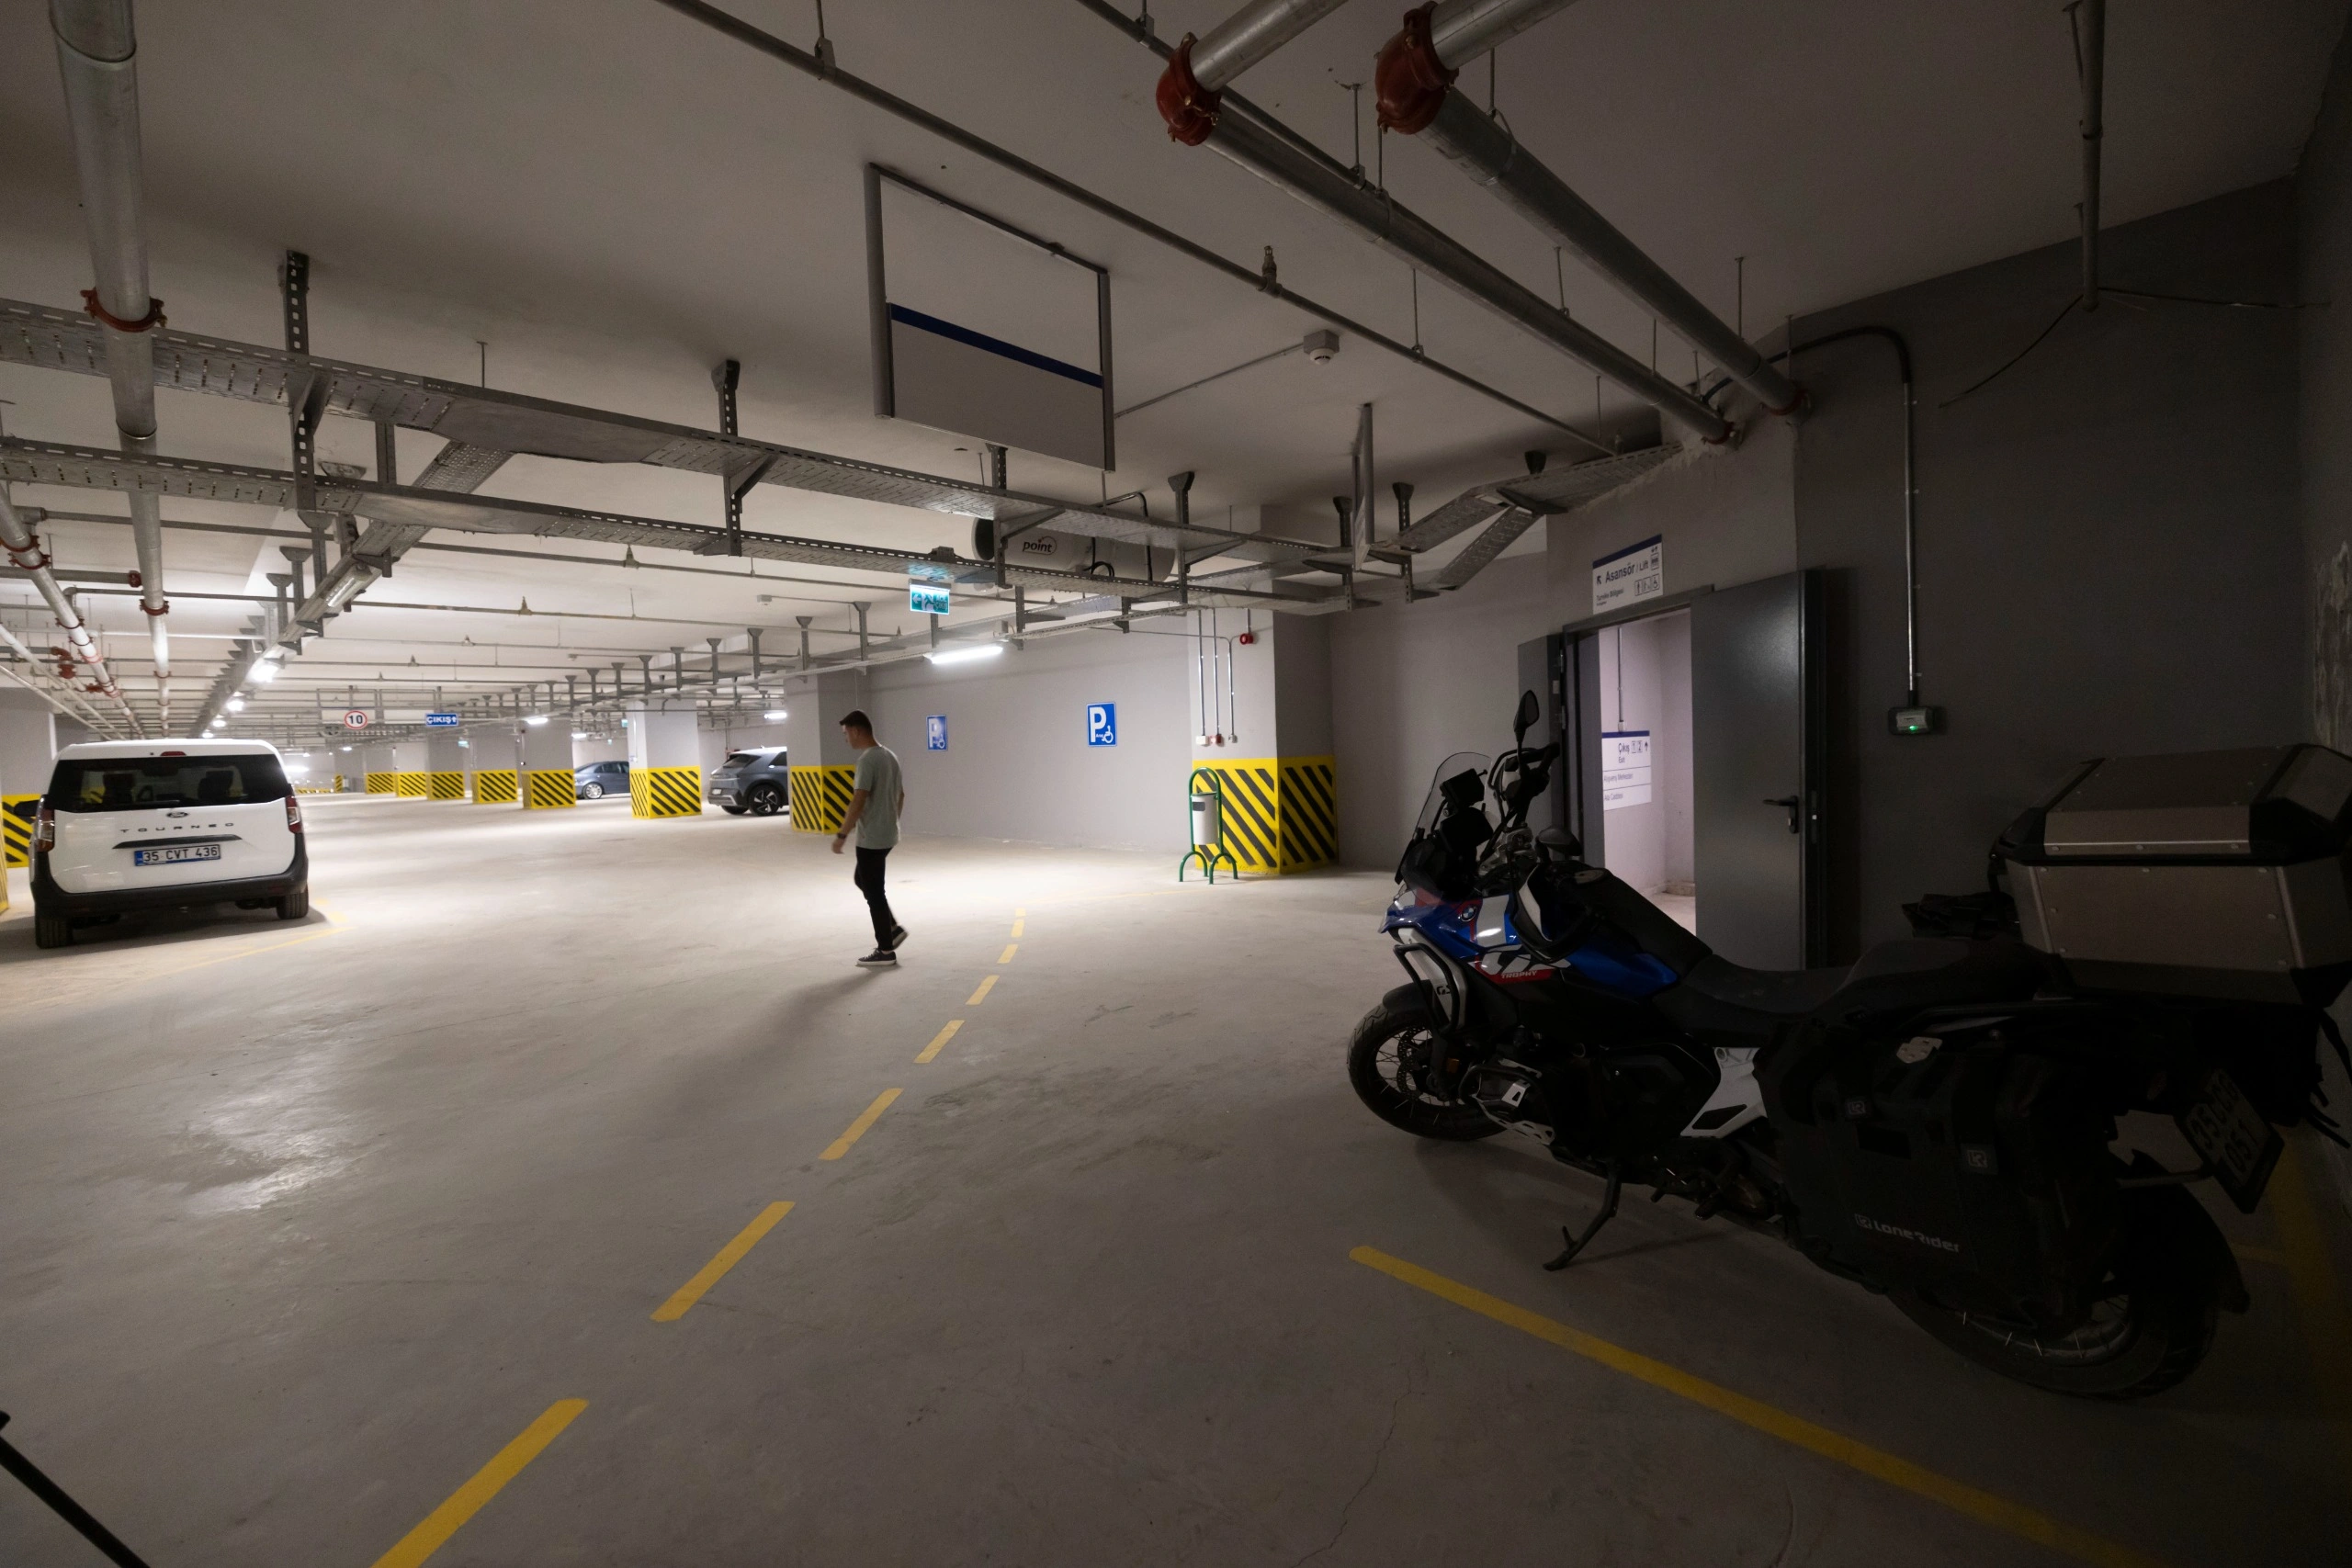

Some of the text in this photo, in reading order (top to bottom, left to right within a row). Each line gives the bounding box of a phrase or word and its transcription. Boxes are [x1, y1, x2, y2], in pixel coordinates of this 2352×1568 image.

[1023, 537, 1053, 553] point
[1605, 561, 1635, 583] Asansör
[1639, 559, 1649, 571] Lift
[348, 715, 363, 725] 10
[426, 716, 451, 725] ÇIKIŞ
[1090, 706, 1106, 743] P
[929, 718, 941, 748] P
[120, 822, 234, 833] TOURNEO
[143, 852, 159, 862] 35
[165, 849, 189, 860] CVT
[195, 847, 218, 857] 436
[1500, 970, 1538, 979] TROPHY
